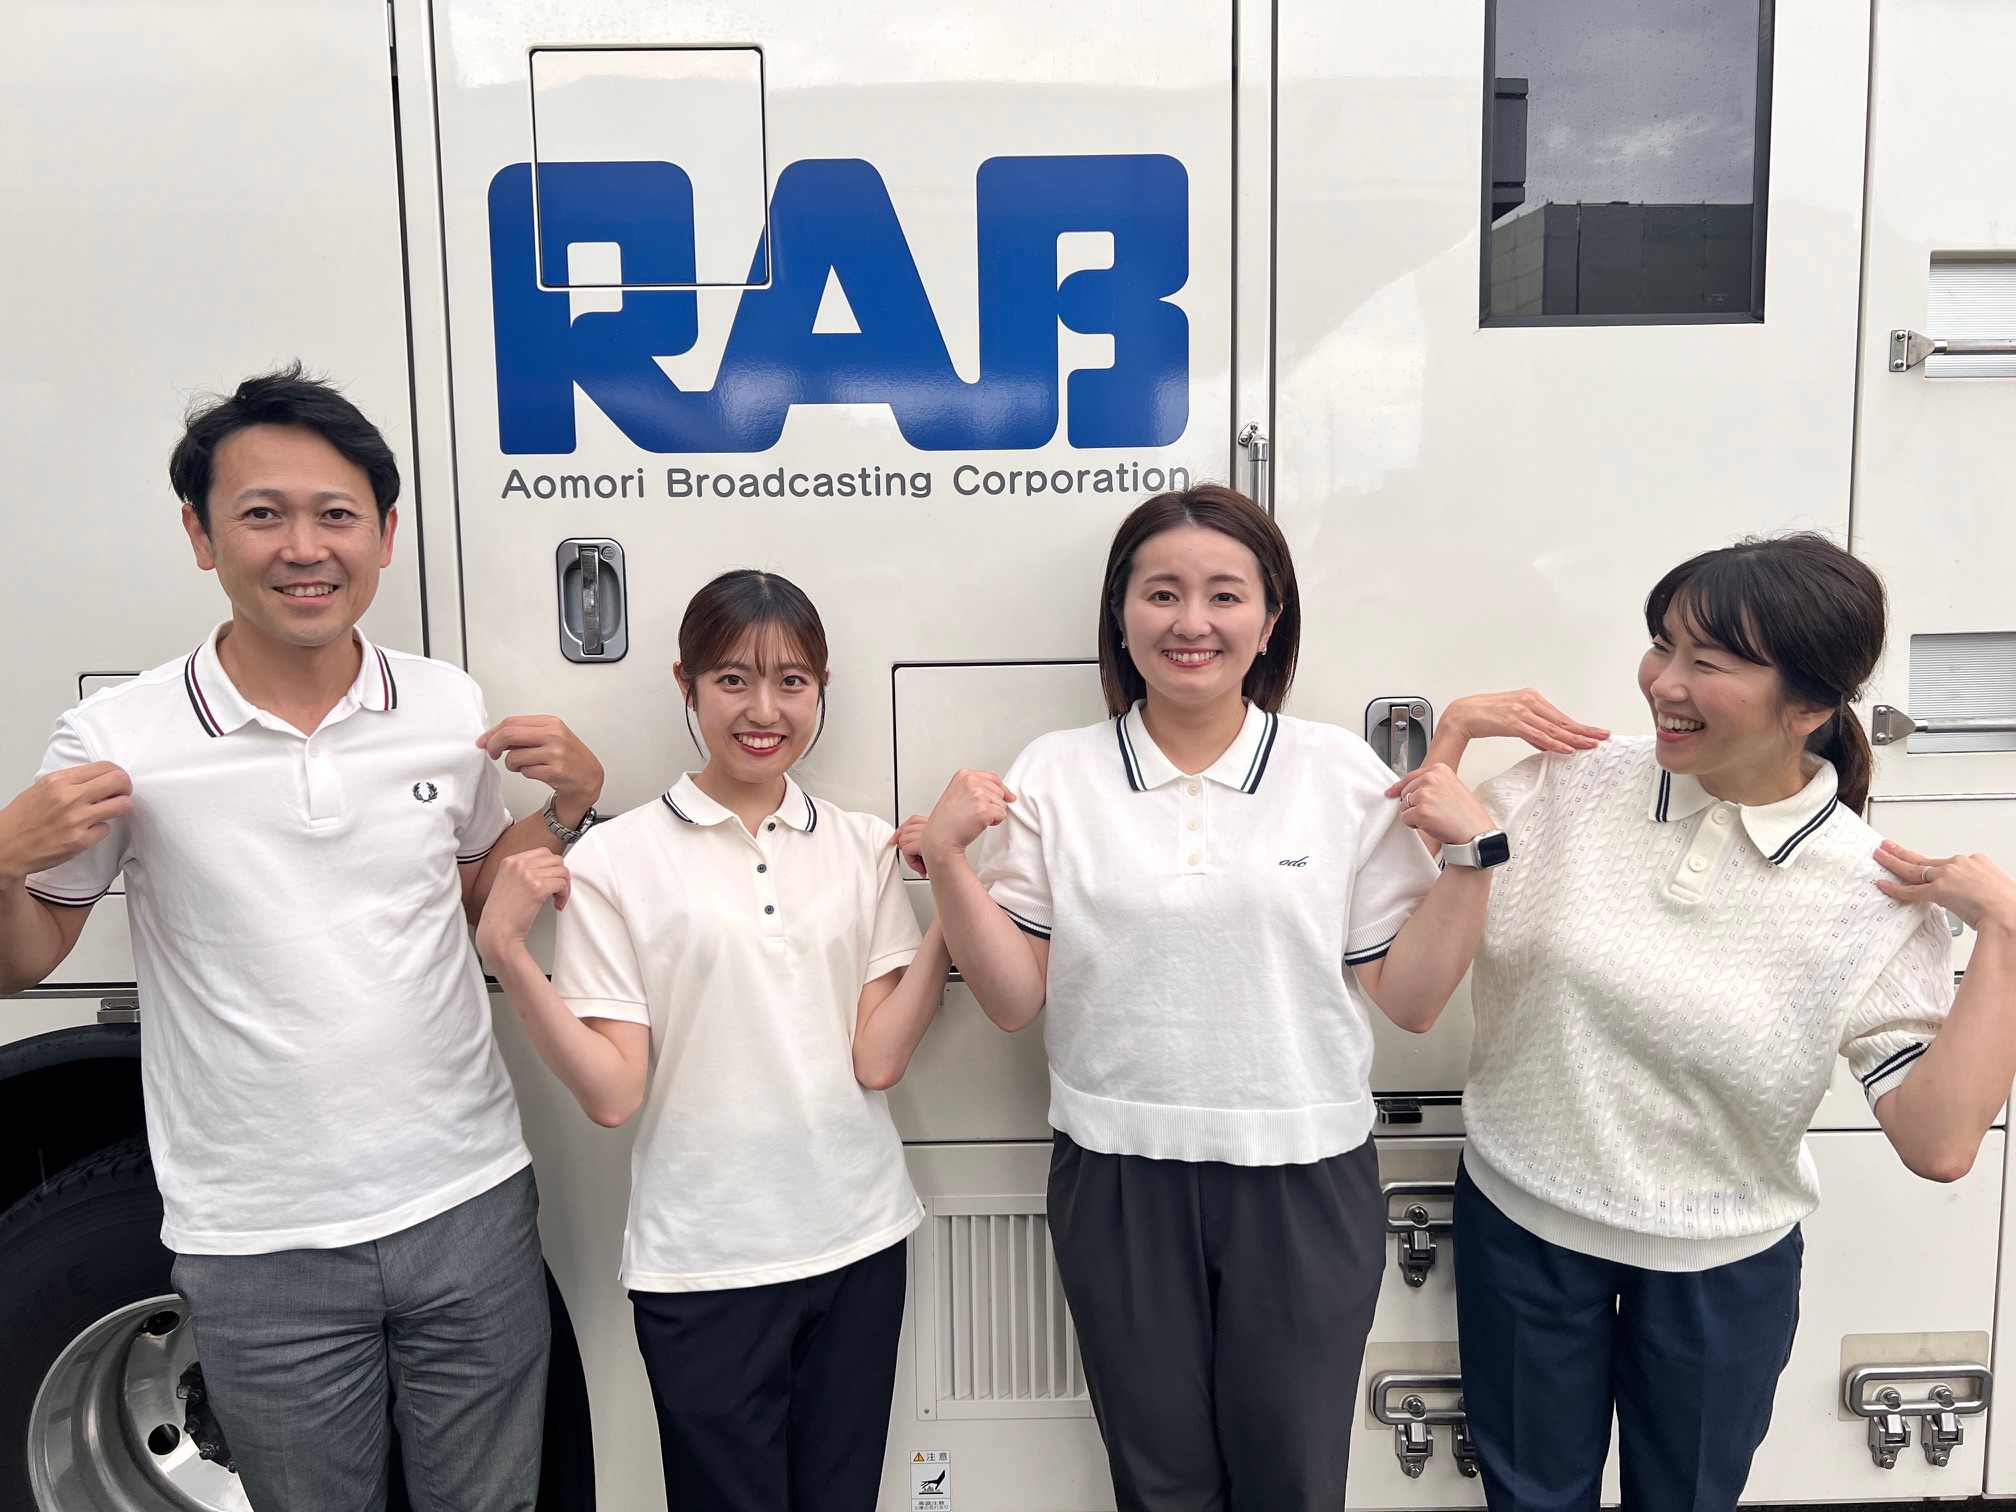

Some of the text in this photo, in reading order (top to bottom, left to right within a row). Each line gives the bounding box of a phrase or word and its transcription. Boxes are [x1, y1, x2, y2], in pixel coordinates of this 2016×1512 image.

[488, 154, 1189, 454] RAB
[501, 461, 1190, 500] Aomori Broadcasting Corporation
[926, 1452, 947, 1461] 注意
